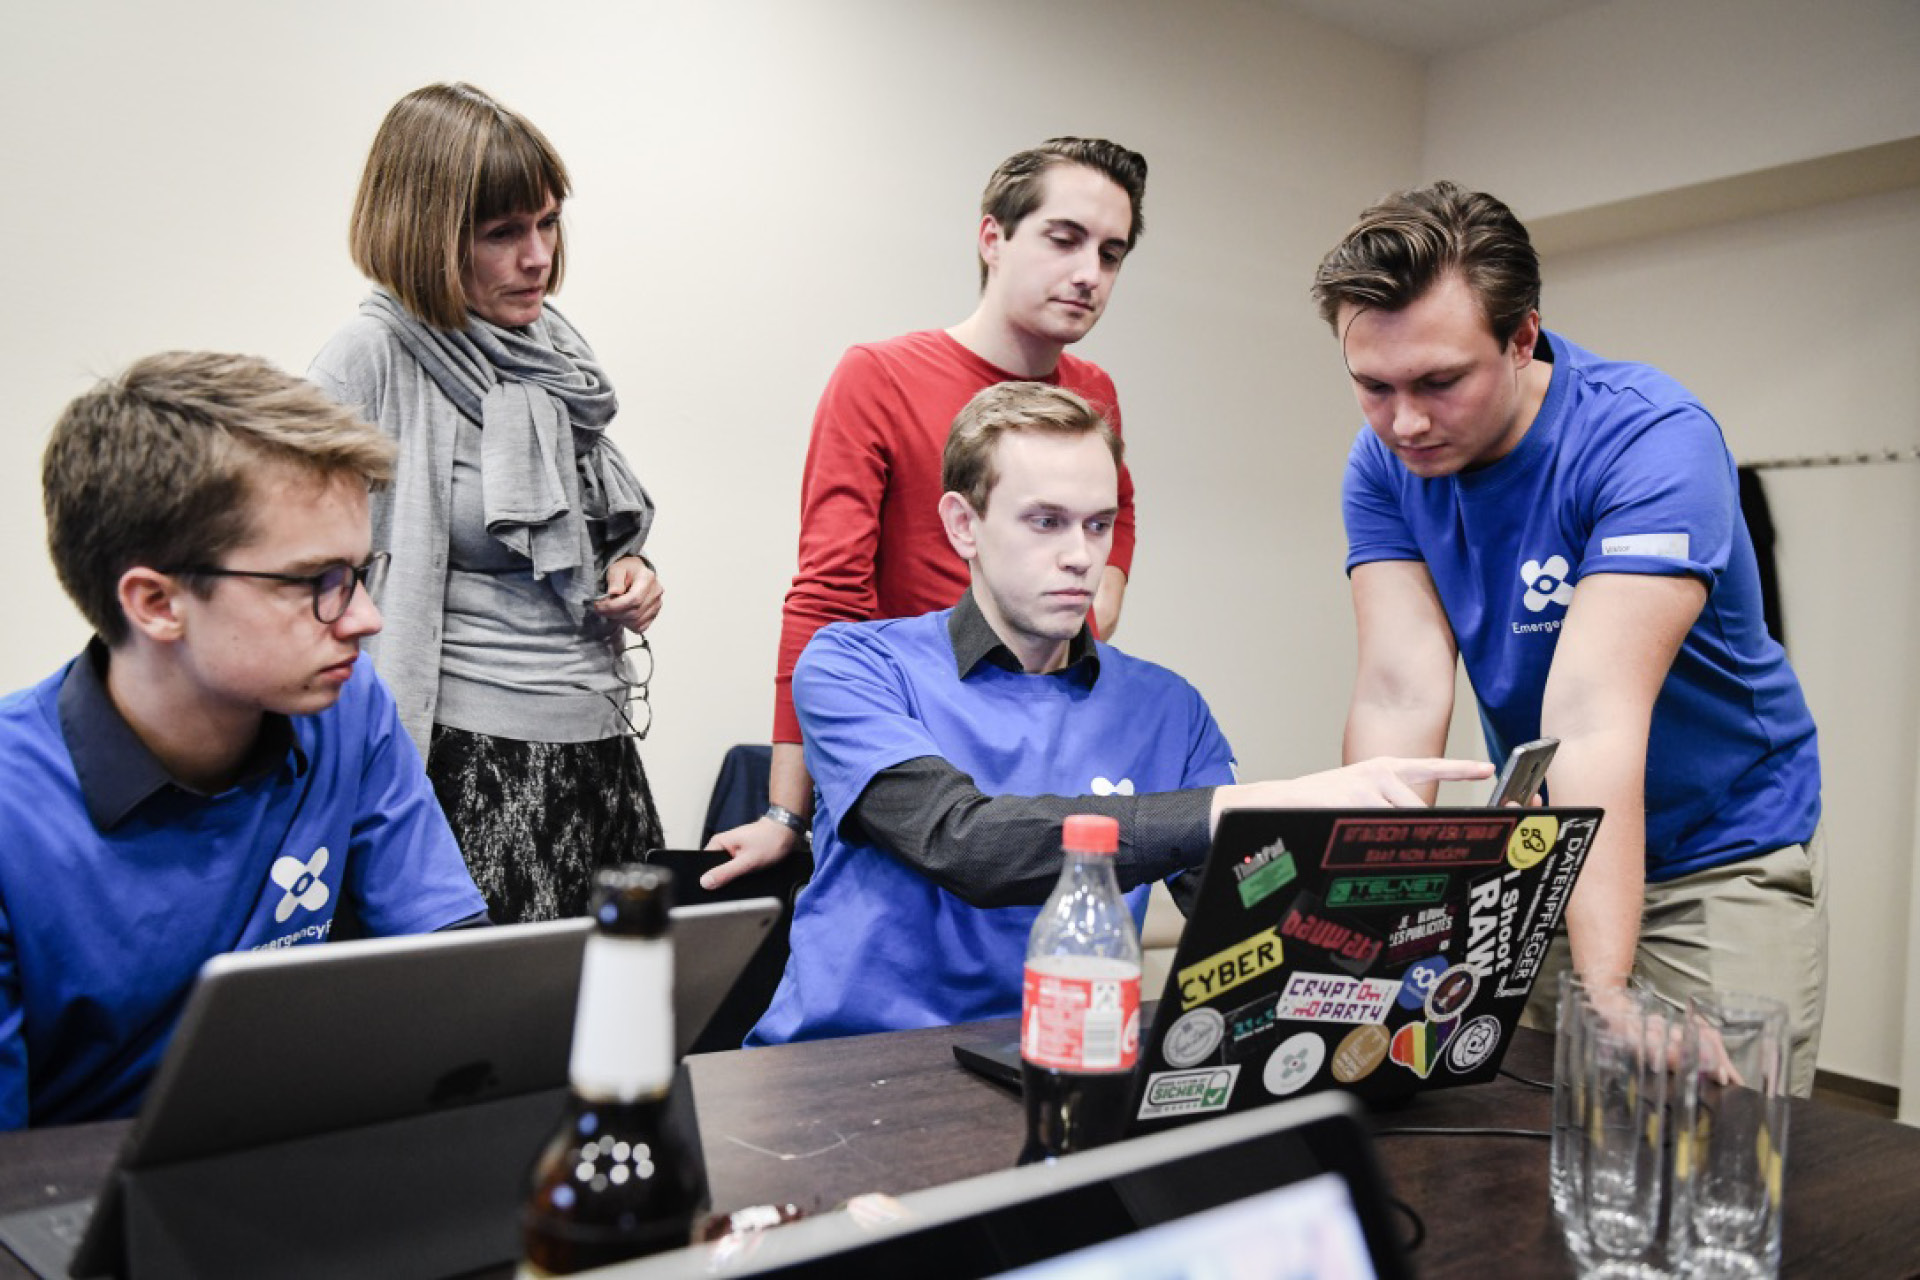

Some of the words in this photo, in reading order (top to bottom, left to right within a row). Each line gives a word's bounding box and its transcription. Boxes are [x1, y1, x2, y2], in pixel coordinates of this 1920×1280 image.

[1466, 876, 1502, 978] RAW
[1181, 942, 1274, 1003] CYBER
[1318, 1001, 1383, 1021] PARTY
